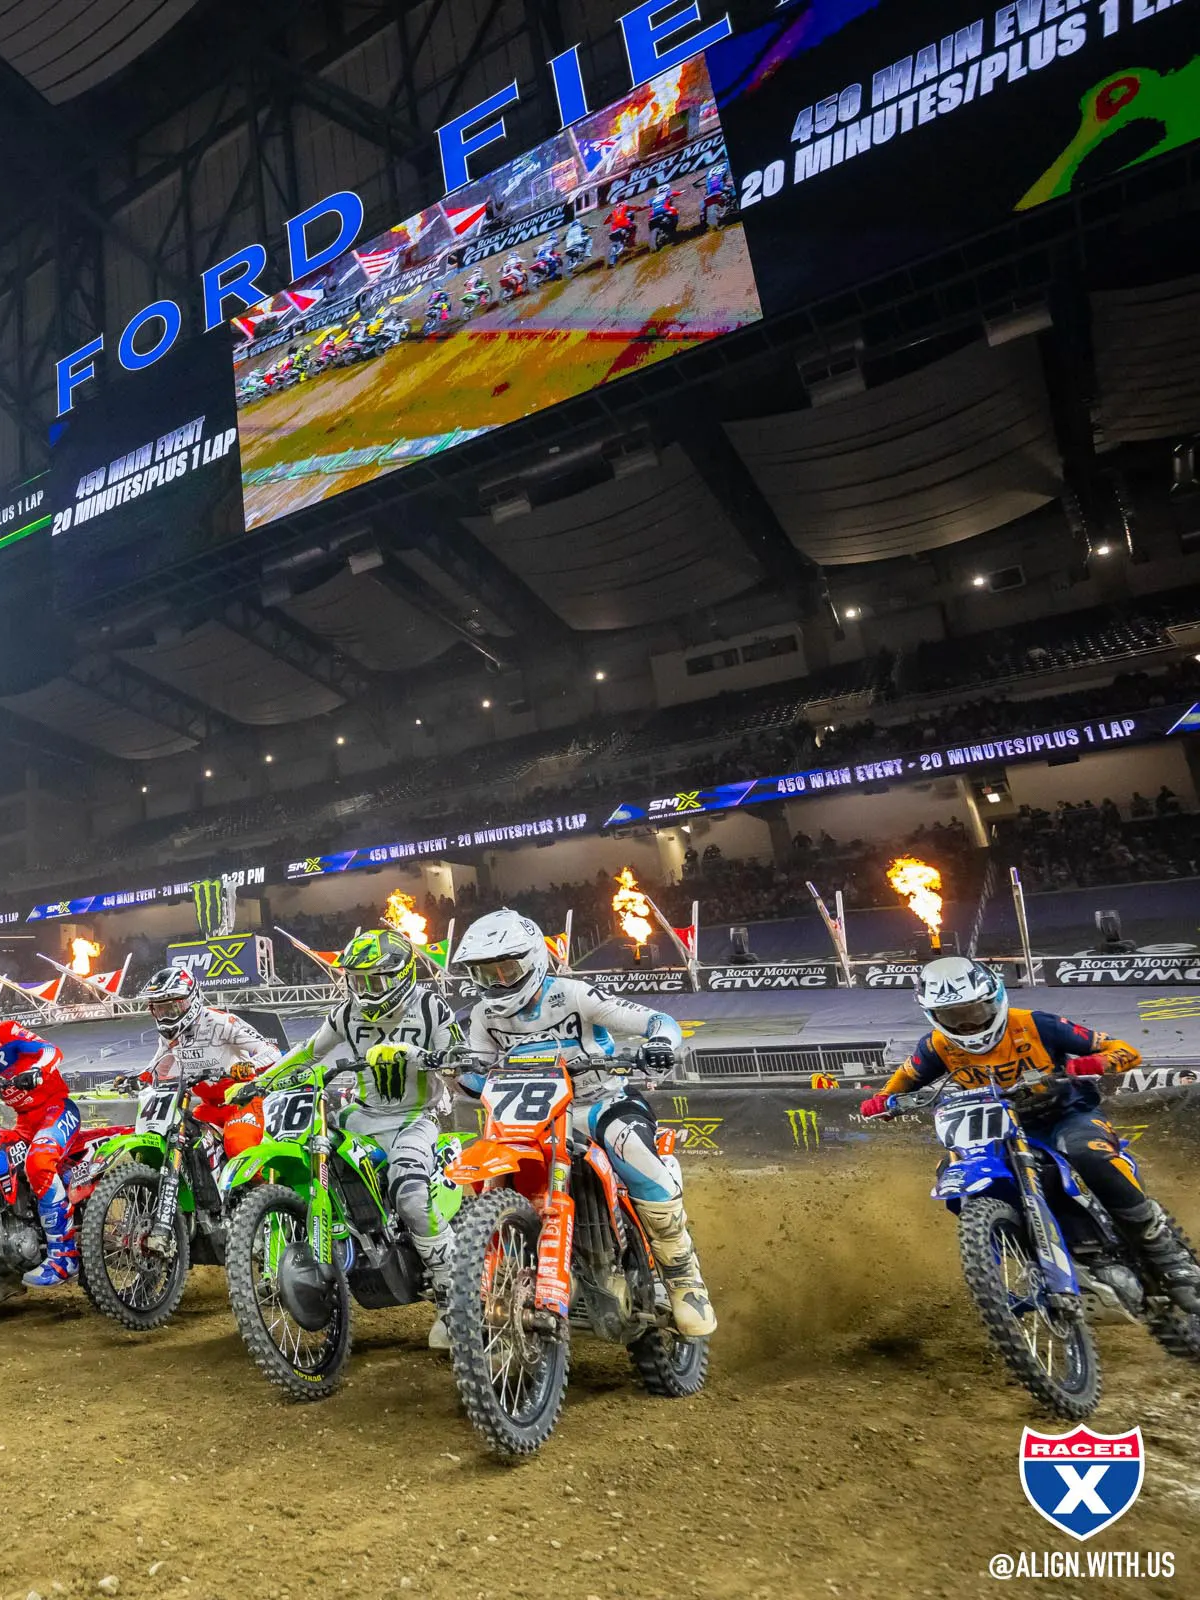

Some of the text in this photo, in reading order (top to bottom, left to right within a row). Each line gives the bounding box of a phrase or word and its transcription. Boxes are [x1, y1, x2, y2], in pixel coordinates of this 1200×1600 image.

[790, 82, 862, 143] 450
[872, 19, 983, 108] MAIN
[740, 159, 785, 210] 20
[794, 12, 1087, 184] MINUTES/PLUS
[55, 0, 798, 417] FORD FIE
[75, 415, 206, 500] 450 MAIN EVENT
[52, 427, 237, 537] 20 MINUTES/PLUS 1 LAP
[25, 489, 44, 514] LAP
[777, 779, 805, 794] 450
[810, 767, 850, 790] MAIN
[856, 758, 903, 782] EVENT
[920, 752, 942, 772] 20
[949, 727, 1080, 766] MINUTES/PLUS
[1084, 725, 1095, 743] 1
[1099, 719, 1136, 741] LAP
[648, 791, 702, 812] SMX
[369, 847, 388, 861] 450
[390, 843, 416, 858] MAIN
[418, 837, 447, 853] EVENT
[458, 835, 472, 847] 20
[565, 813, 587, 830] LAP
[247, 867, 265, 886] PM
[287, 856, 322, 873] SMX
[47, 900, 71, 914] SMX
[103, 886, 172, 907] 450 MAIN EVENT 20
[171, 941, 246, 978] SMX
[726, 966, 826, 978] ROCKY MOUNTAIN
[1081, 958, 1128, 970] ROCKY
[198, 976, 250, 987] HAMPIONSHIP
[595, 971, 683, 983] ROCKY MOUNTAIN
[355, 1026, 422, 1047] FXR
[141, 1092, 176, 1122] 41
[266, 1094, 315, 1137] 36
[491, 1081, 558, 1121] 78
[938, 1105, 1004, 1148] 711
[321, 1208, 330, 1264] DUNLOP
